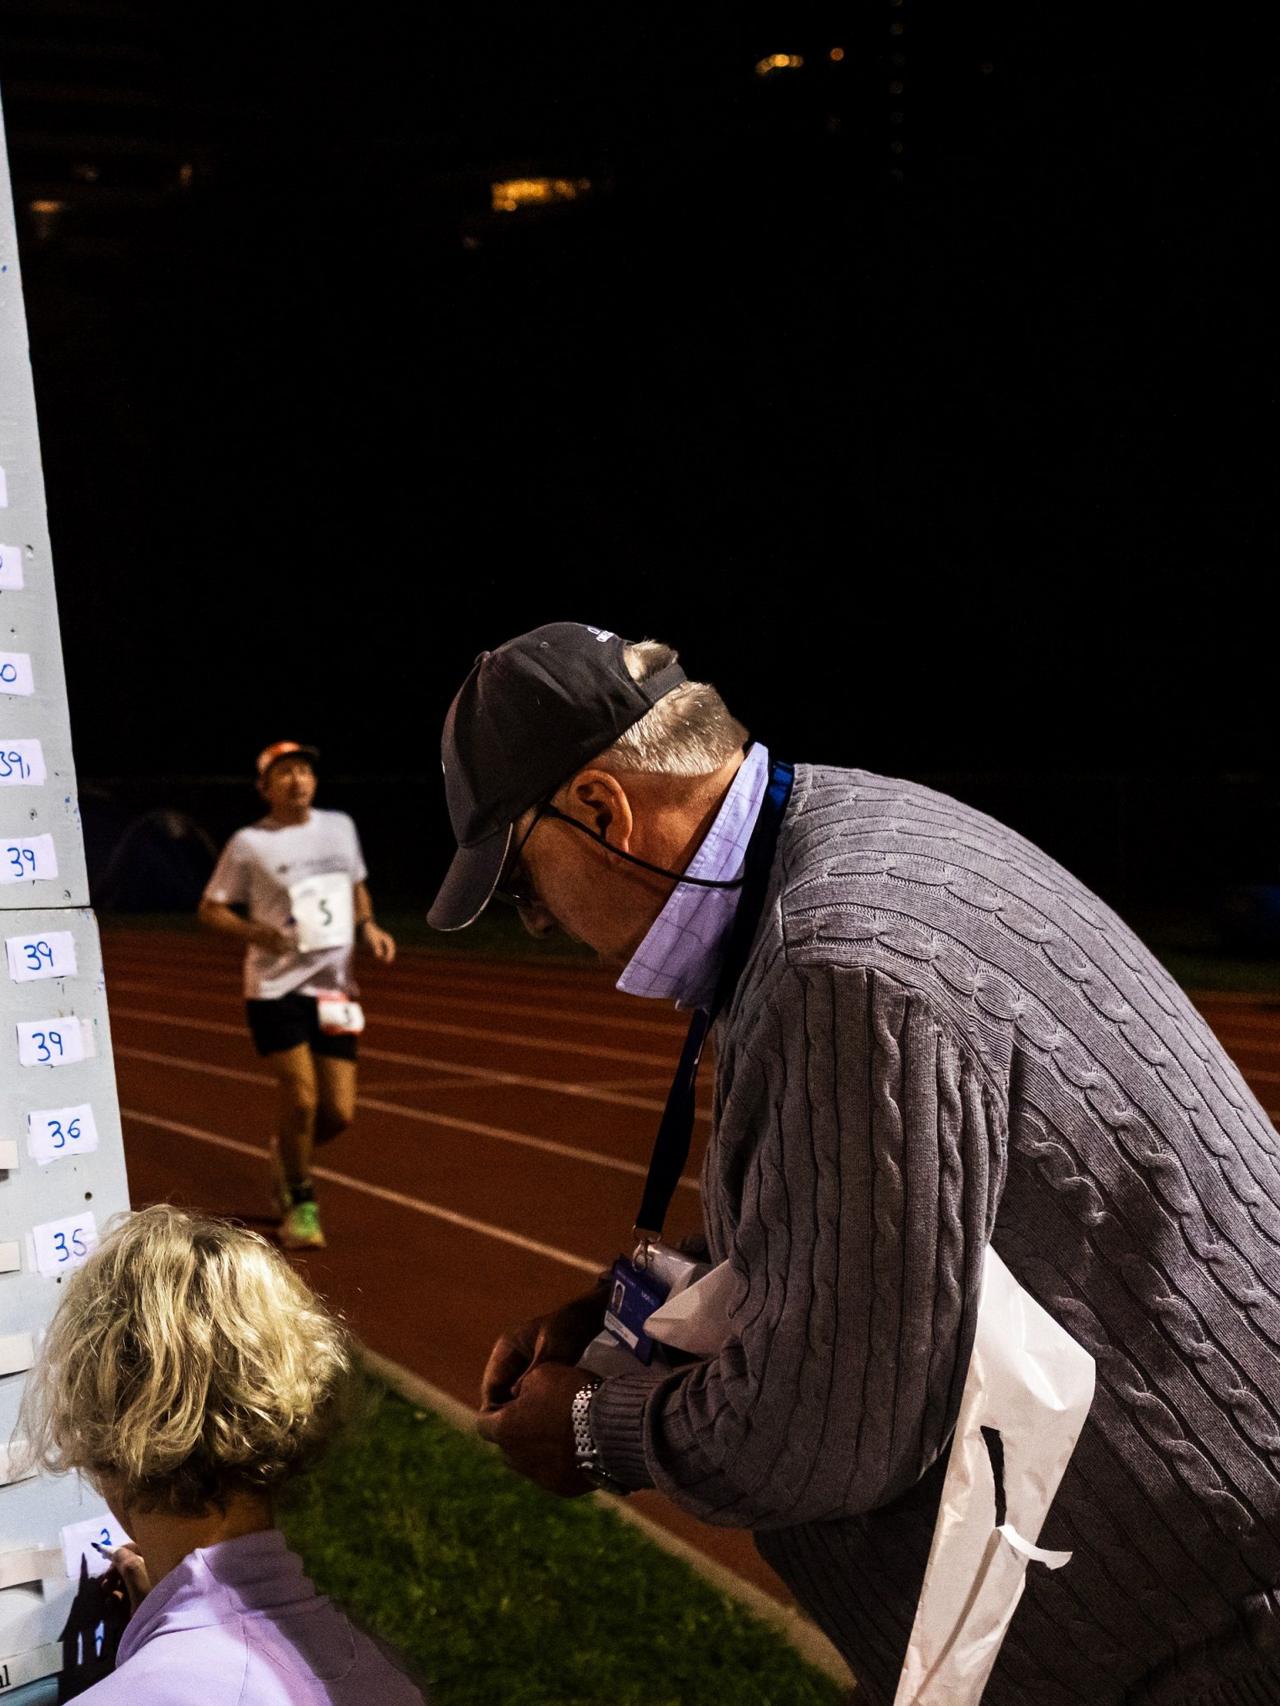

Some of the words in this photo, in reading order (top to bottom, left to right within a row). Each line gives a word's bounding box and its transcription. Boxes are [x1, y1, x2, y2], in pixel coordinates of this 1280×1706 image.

[7, 848, 37, 877] 39
[23, 942, 52, 971] 39
[32, 1032, 63, 1062] 39
[48, 1119, 81, 1148] 36
[54, 1228, 88, 1263] 35
